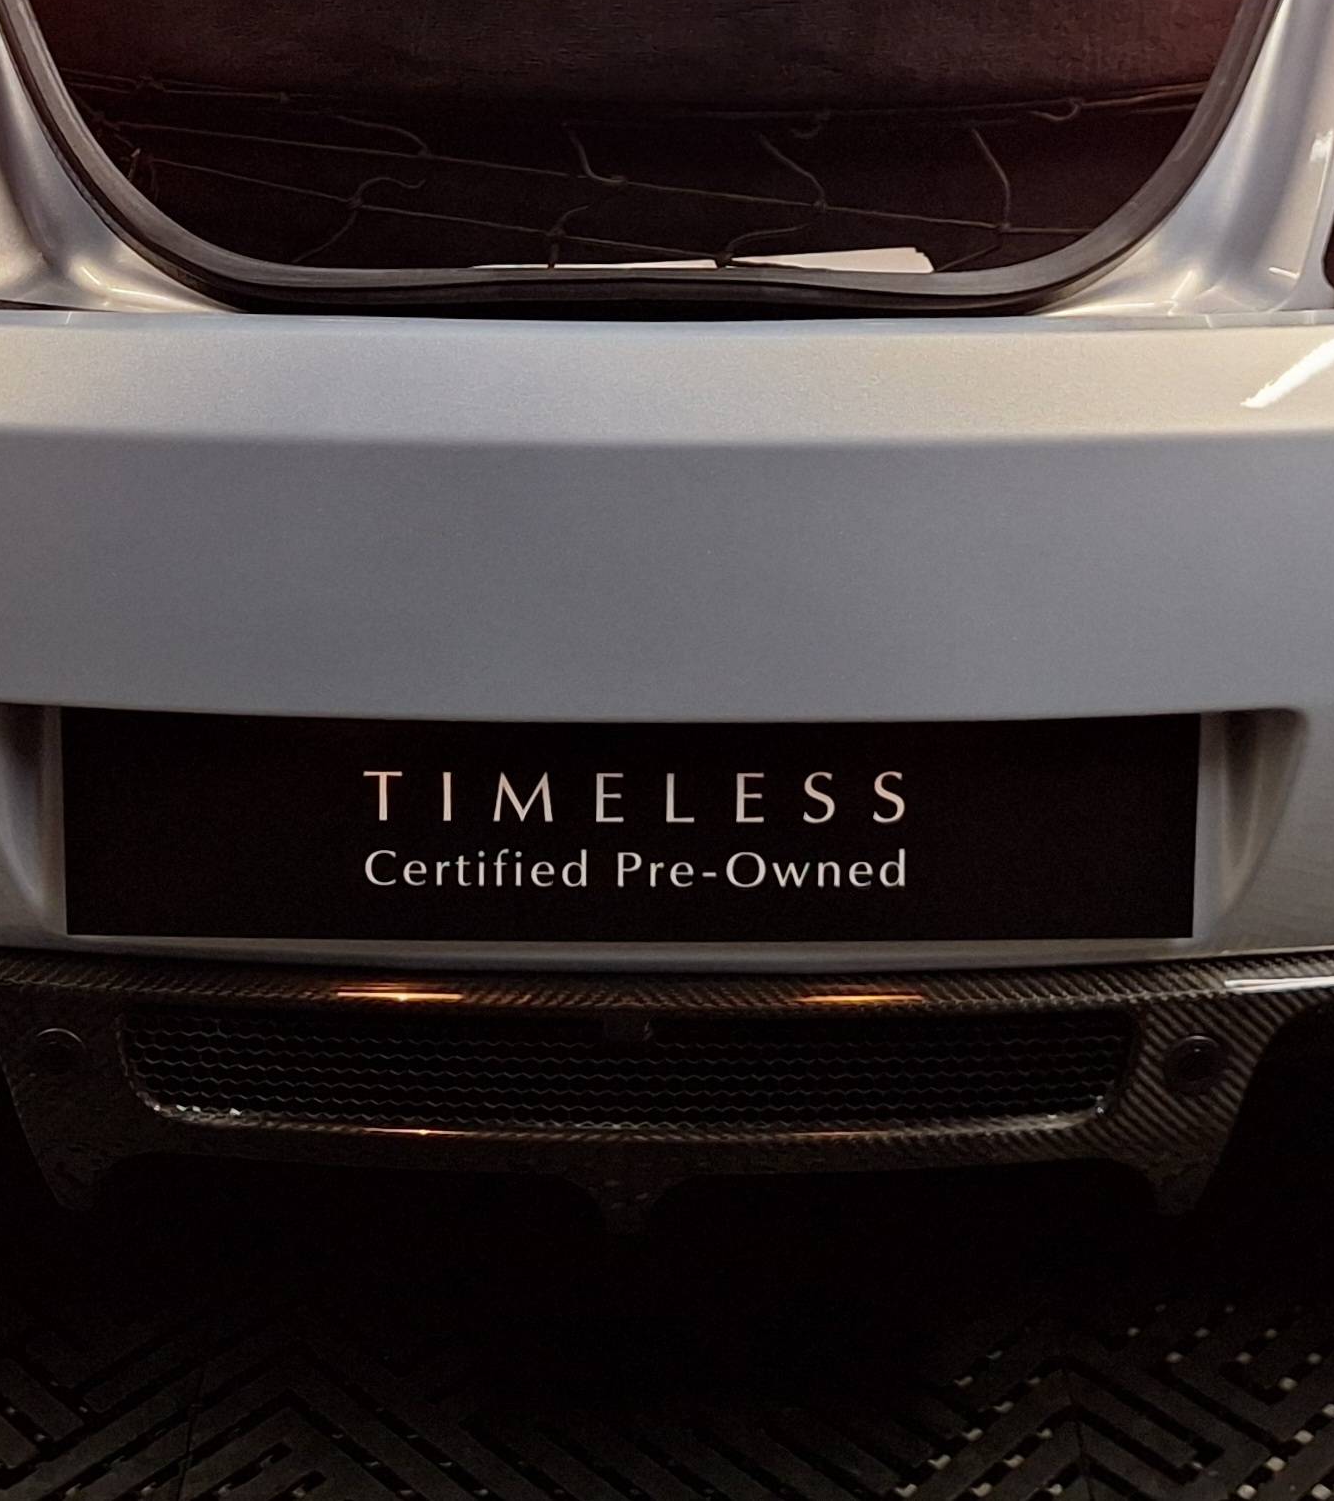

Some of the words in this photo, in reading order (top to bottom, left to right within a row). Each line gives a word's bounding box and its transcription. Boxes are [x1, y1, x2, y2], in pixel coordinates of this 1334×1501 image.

[363, 770, 906, 825] TIMELESS
[364, 848, 588, 888] Certified
[617, 847, 907, 889] Pre-Owned
